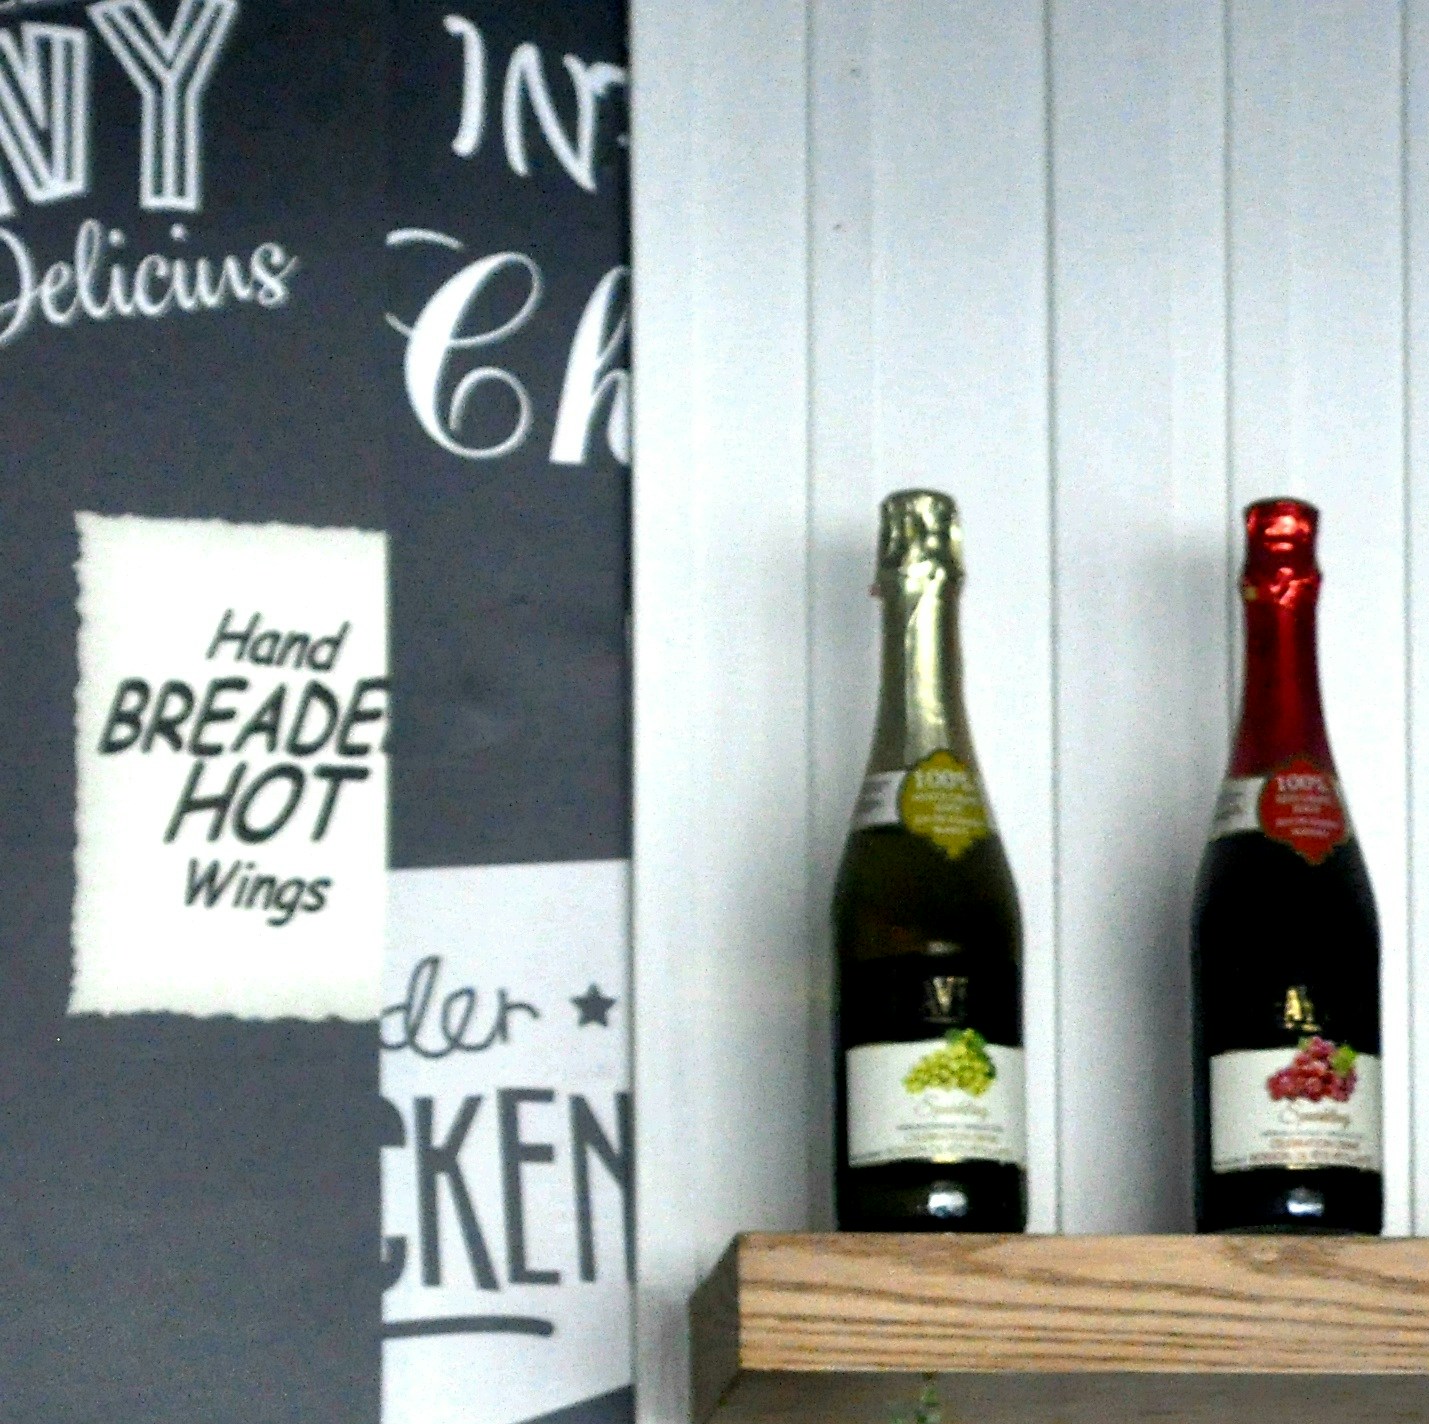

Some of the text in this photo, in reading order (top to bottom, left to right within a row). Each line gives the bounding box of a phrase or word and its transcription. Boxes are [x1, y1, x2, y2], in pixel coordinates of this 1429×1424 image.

[205, 609, 350, 671] Hand
[99, 677, 391, 757] BREADE
[164, 761, 370, 845] HOT
[184, 857, 333, 927] Wings
